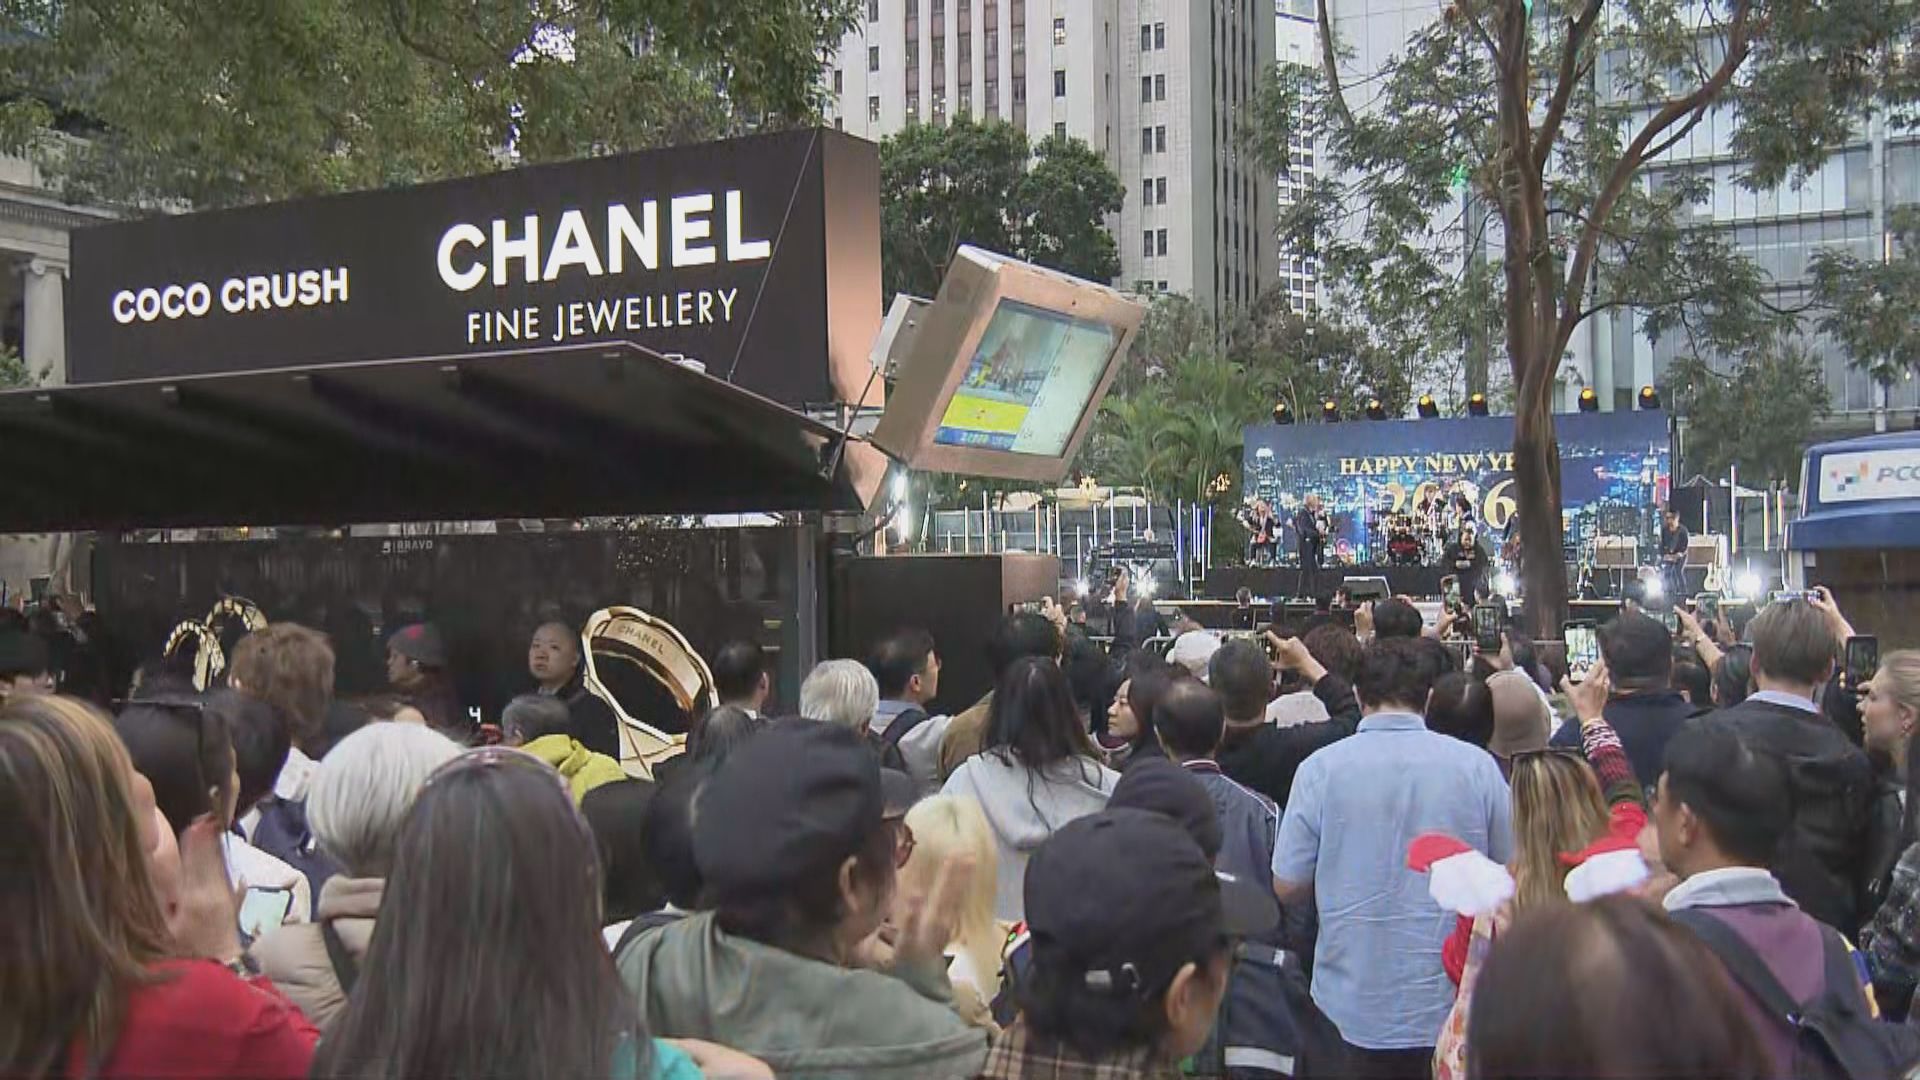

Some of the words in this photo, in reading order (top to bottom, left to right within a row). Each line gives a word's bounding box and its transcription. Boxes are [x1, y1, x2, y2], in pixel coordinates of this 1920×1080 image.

[437, 190, 770, 291] CHANEL
[112, 281, 212, 324] COCO
[220, 267, 349, 314] CRUSH
[467, 306, 540, 343] FINE
[552, 288, 738, 342] JEWELLERY
[1339, 456, 1420, 475] HAPPY
[1425, 453, 1481, 473] NEW
[618, 624, 665, 655] CHANEL
